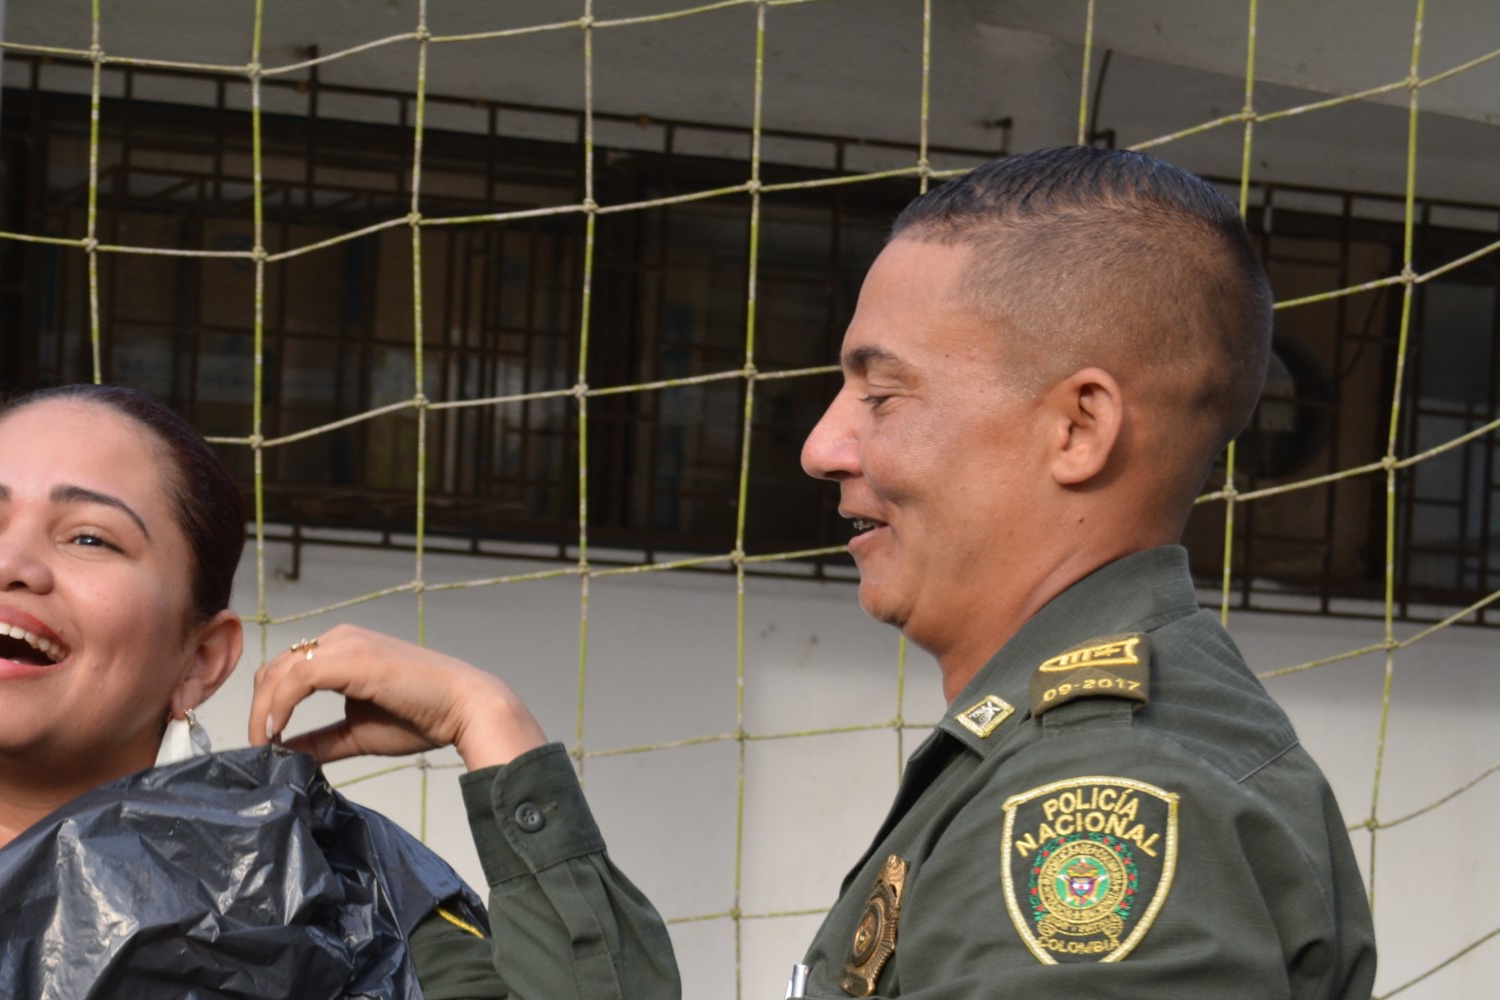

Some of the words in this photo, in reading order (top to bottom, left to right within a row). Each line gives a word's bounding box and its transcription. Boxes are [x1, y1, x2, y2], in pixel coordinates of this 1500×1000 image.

[1043, 678, 1141, 701] 09-2017
[1042, 787, 1139, 821] POLICÍA
[1015, 812, 1160, 858] NACIONAL
[1037, 936, 1121, 954] COLOMBIA
